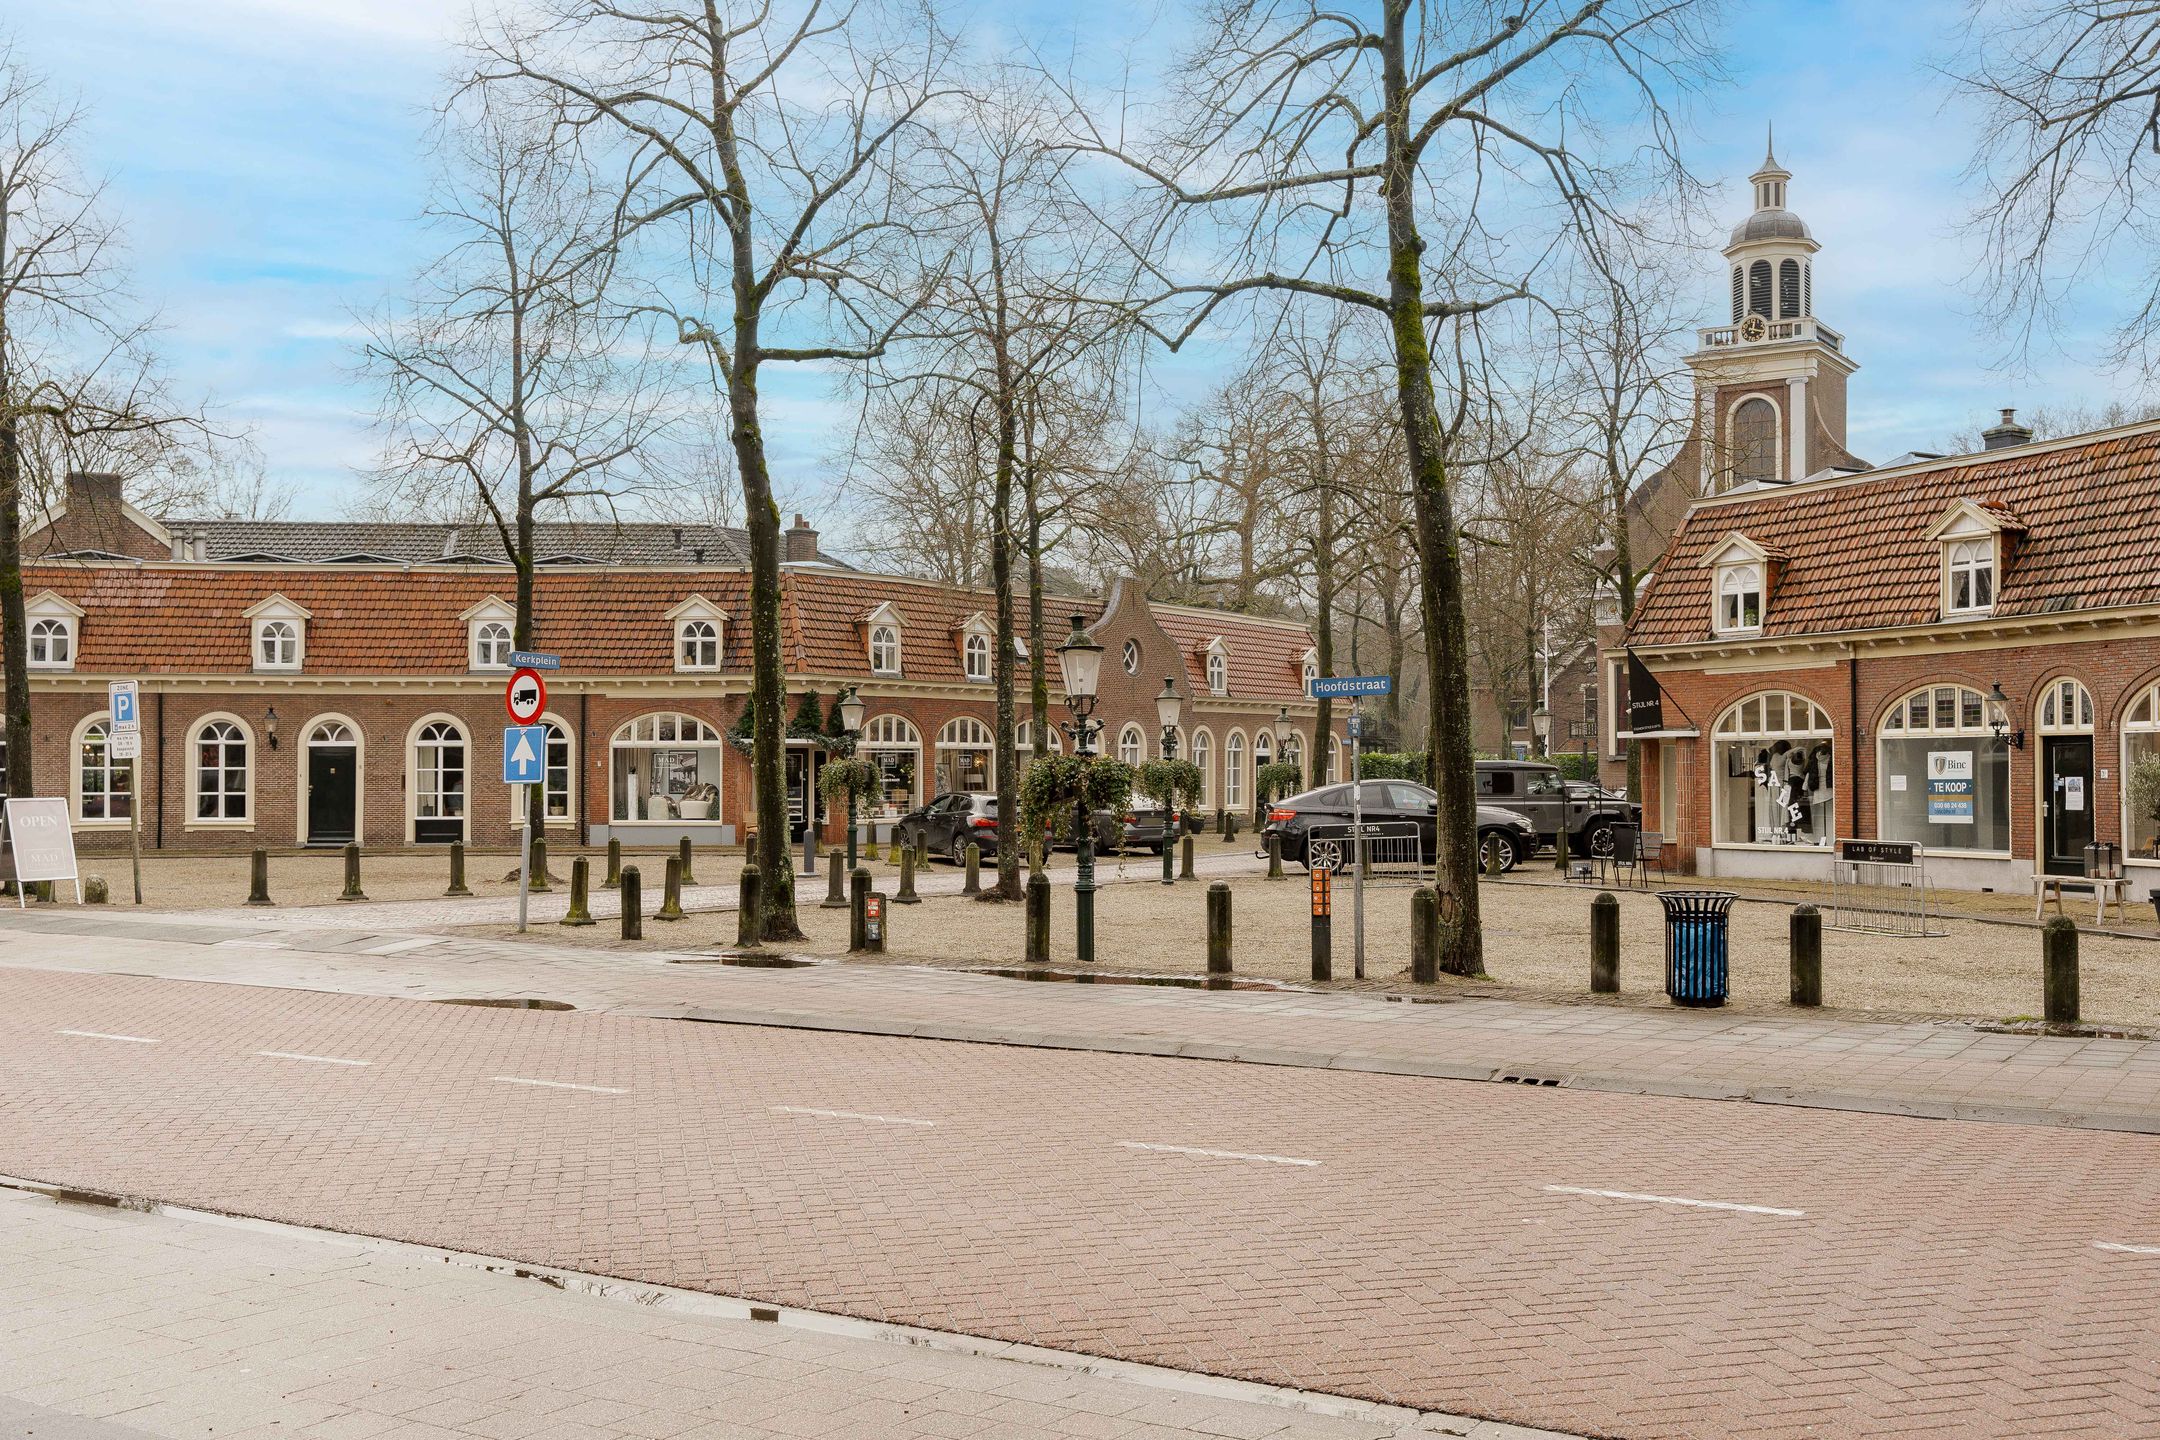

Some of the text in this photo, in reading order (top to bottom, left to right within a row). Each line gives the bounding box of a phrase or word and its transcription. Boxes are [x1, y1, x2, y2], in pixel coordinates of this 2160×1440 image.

[515, 654, 557, 665] Kerkplein
[1316, 680, 1386, 692] Hoofdstraat
[117, 695, 129, 720] P
[1632, 701, 1646, 709] STIJL
[1947, 759, 1967, 769] Binc
[1934, 782, 1967, 792] TE KOOP
[1754, 765, 1803, 822] SALE
[20, 815, 58, 828] OPEN
[31, 854, 59, 864] MAD
